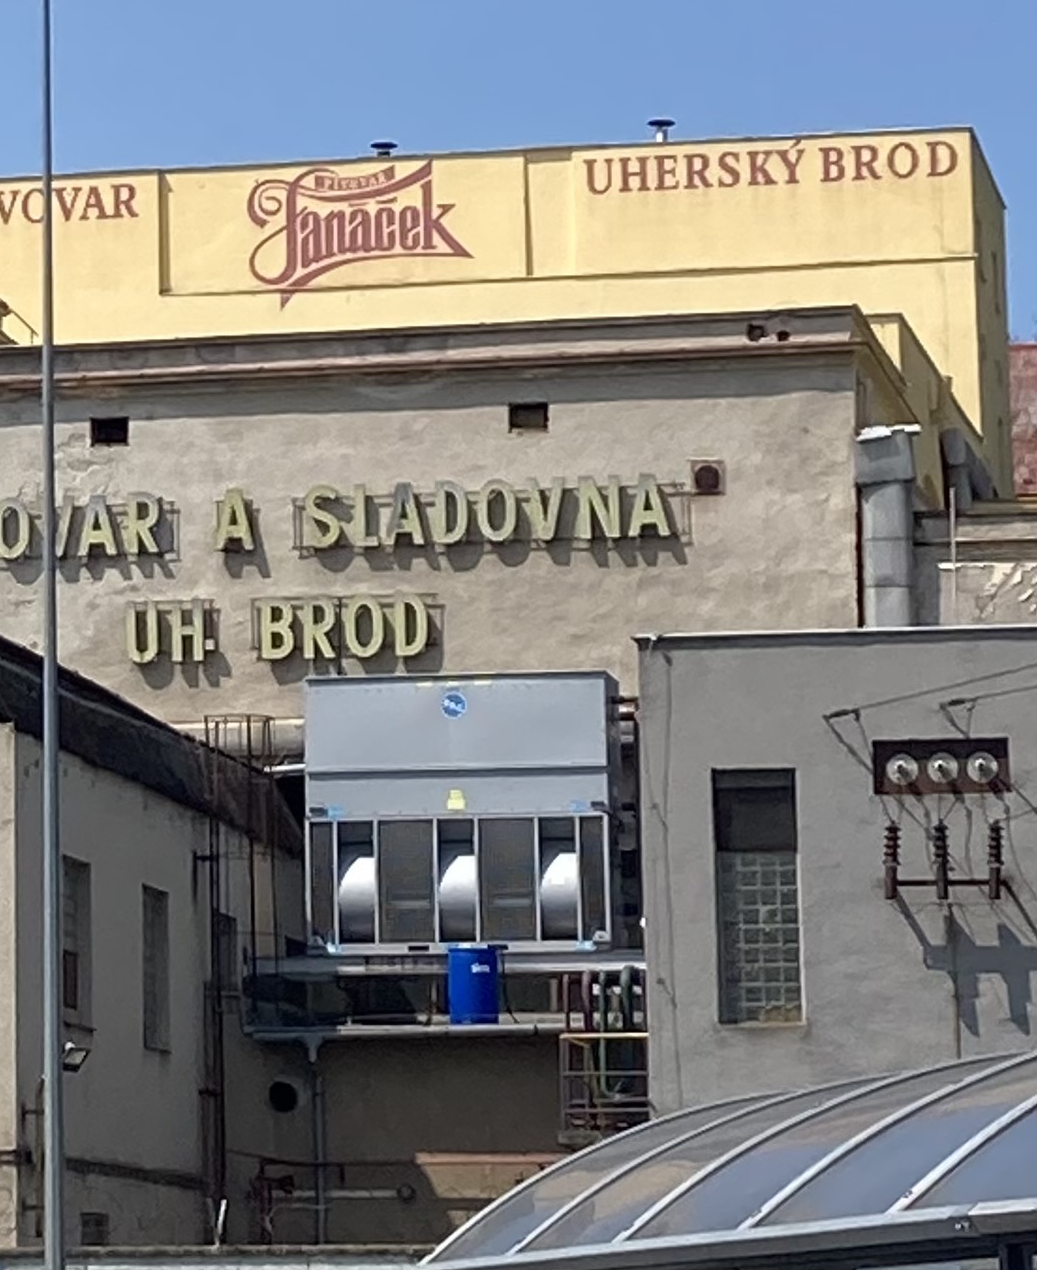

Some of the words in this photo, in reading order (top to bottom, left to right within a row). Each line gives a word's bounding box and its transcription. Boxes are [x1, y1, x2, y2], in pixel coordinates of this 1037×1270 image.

[583, 139, 805, 195] UHERSKÝ
[819, 141, 959, 183] BROD
[215, 488, 255, 552] A
[304, 472, 671, 550] SLADOVNA
[262, 591, 429, 661] BROD
